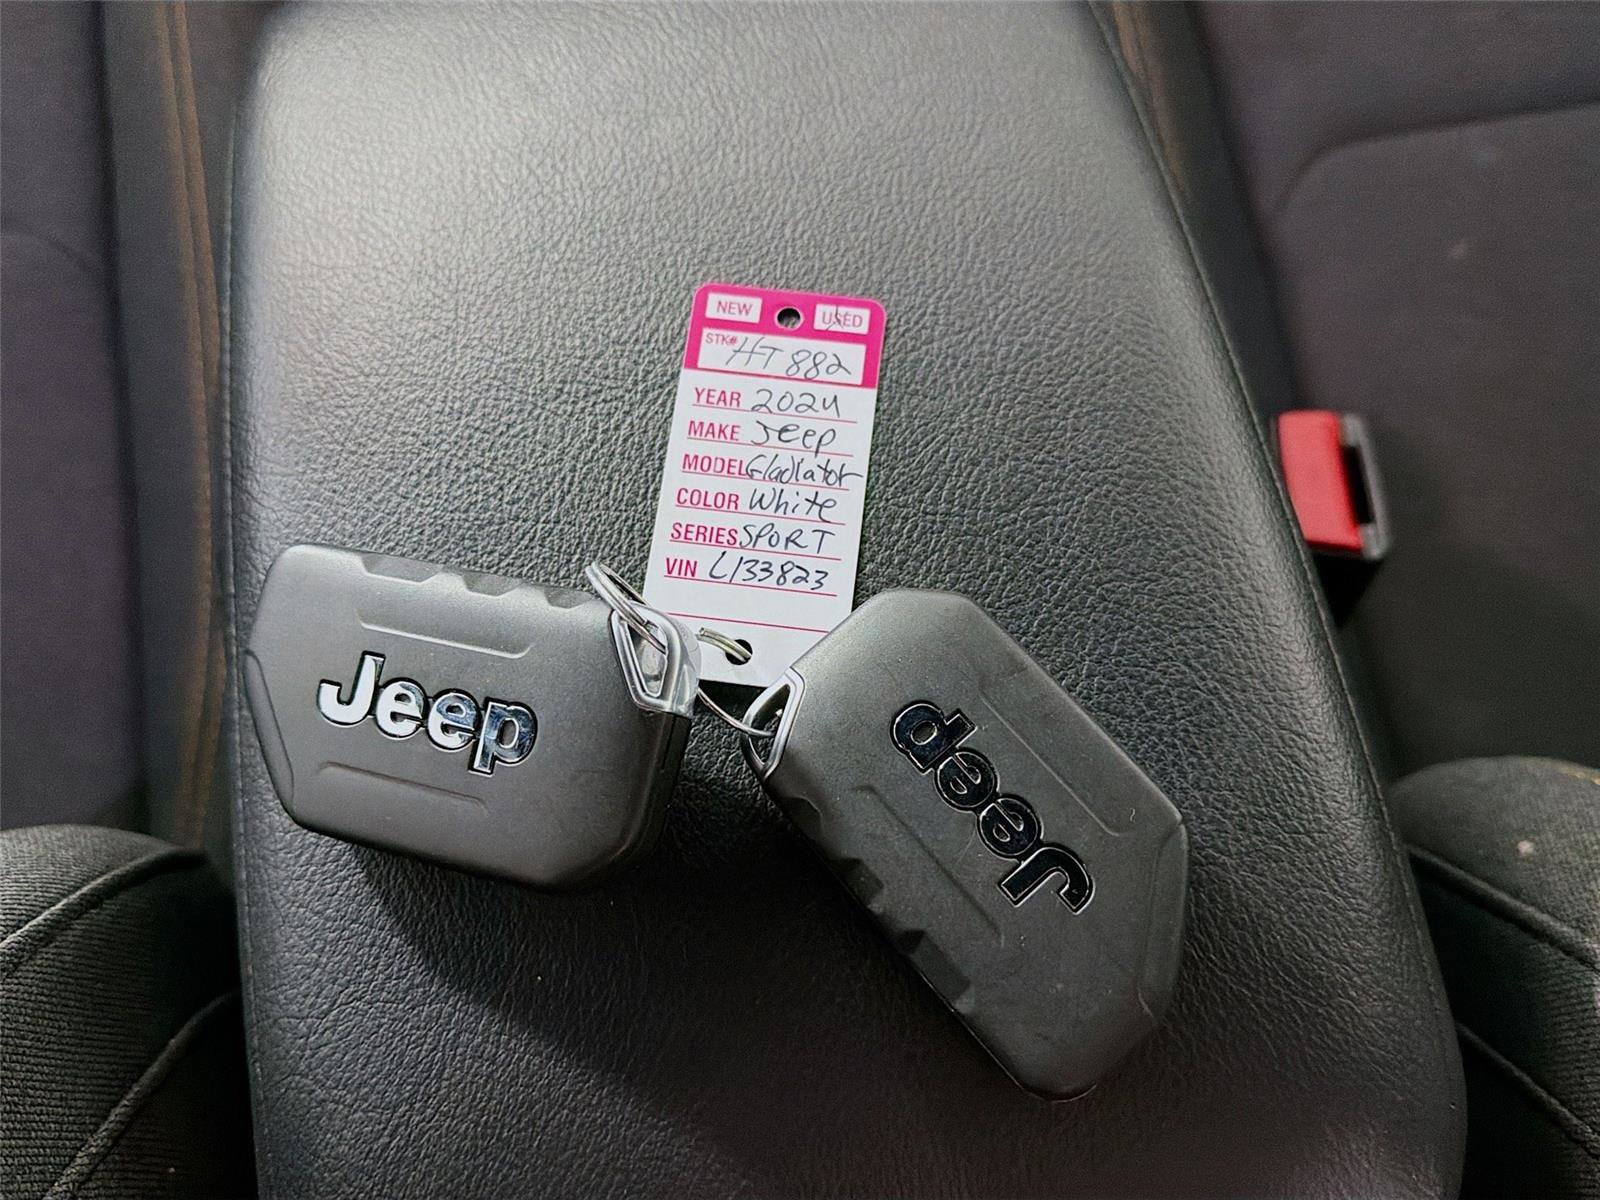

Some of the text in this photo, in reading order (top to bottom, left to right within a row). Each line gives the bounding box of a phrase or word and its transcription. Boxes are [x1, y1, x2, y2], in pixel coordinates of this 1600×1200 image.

[716, 300, 753, 317] NEW
[821, 311, 864, 329] USED
[705, 333, 738, 346] STK#
[694, 387, 840, 418] YEAR 2024
[688, 420, 837, 459] MAKE Jeep
[682, 453, 864, 487] MODEL Gladiator
[676, 487, 837, 523] COLOR White
[670, 522, 836, 554] SERIES SPORT
[664, 557, 698, 578] VIN
[317, 650, 538, 776] Jeep
[890, 700, 1096, 915] Jeep
